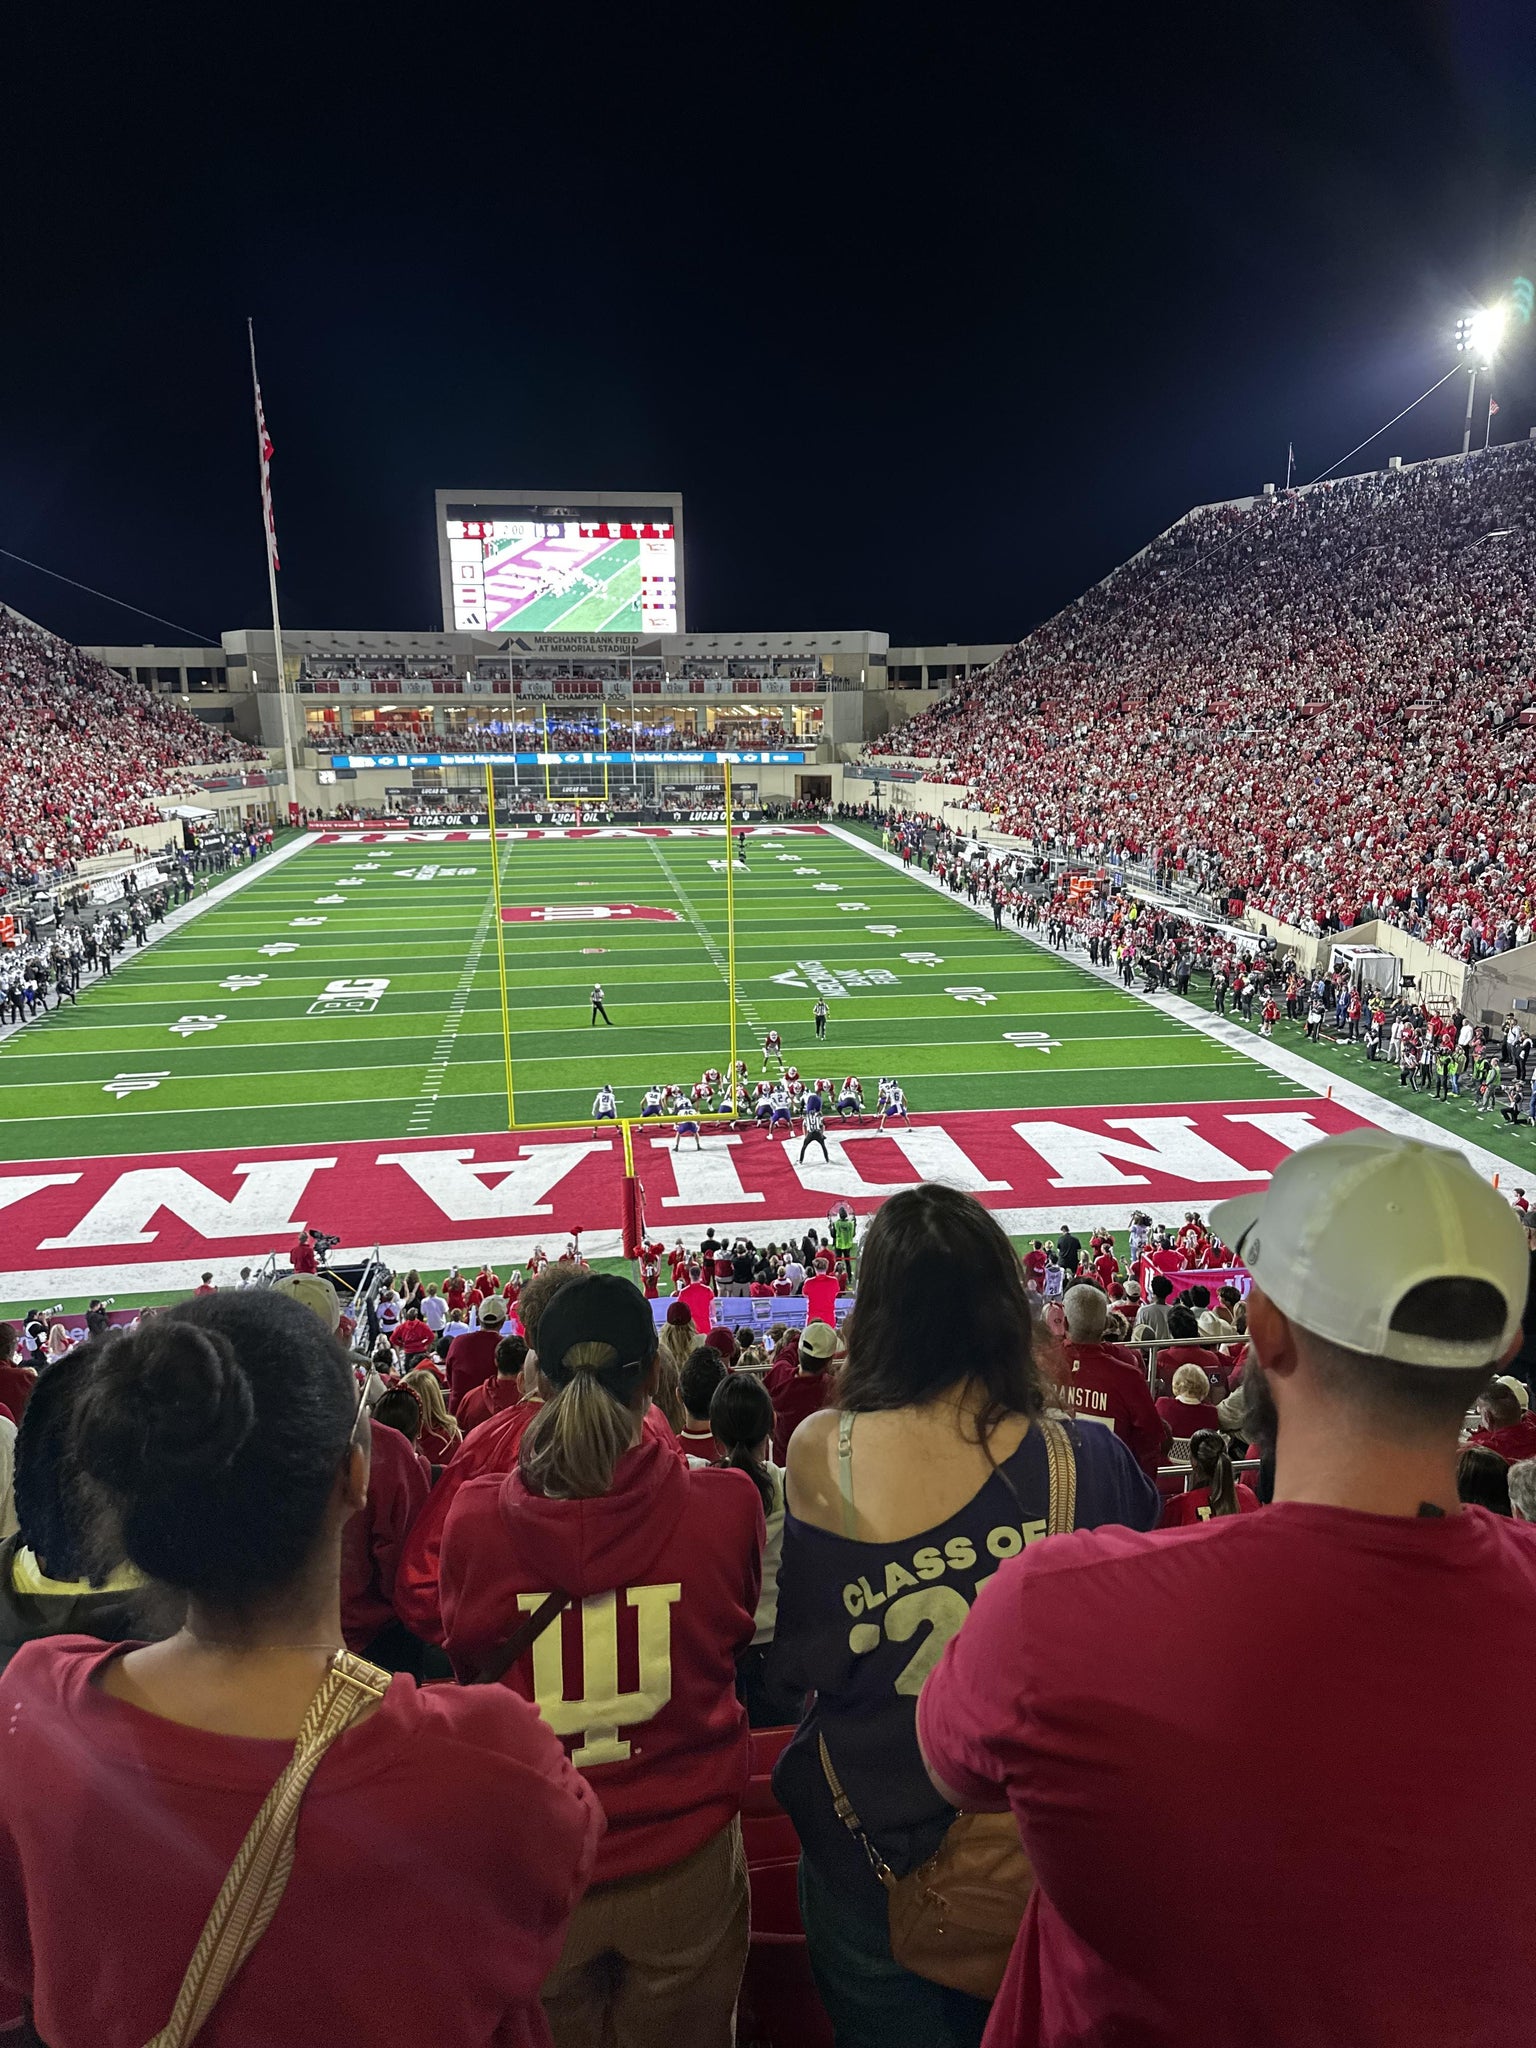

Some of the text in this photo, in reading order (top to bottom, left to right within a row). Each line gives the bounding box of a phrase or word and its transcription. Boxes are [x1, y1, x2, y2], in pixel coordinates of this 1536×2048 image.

[534, 636, 588, 644] MERCHANTS
[590, 636, 614, 644] BANK
[557, 693, 606, 701] CHAMPIONS
[446, 815, 462, 825] OIL
[583, 813, 600, 823] OIL
[689, 811, 735, 821] LUCAS OL
[331, 826, 815, 844] INDIANA
[288, 916, 328, 926] 50
[899, 951, 945, 964] 30
[218, 973, 269, 988] 30
[943, 986, 999, 1001] 20
[168, 1014, 228, 1033] 20
[1002, 1031, 1063, 1048] 10
[102, 1070, 172, 1092] 10
[842, 1519, 1047, 1618] CLASS OF
